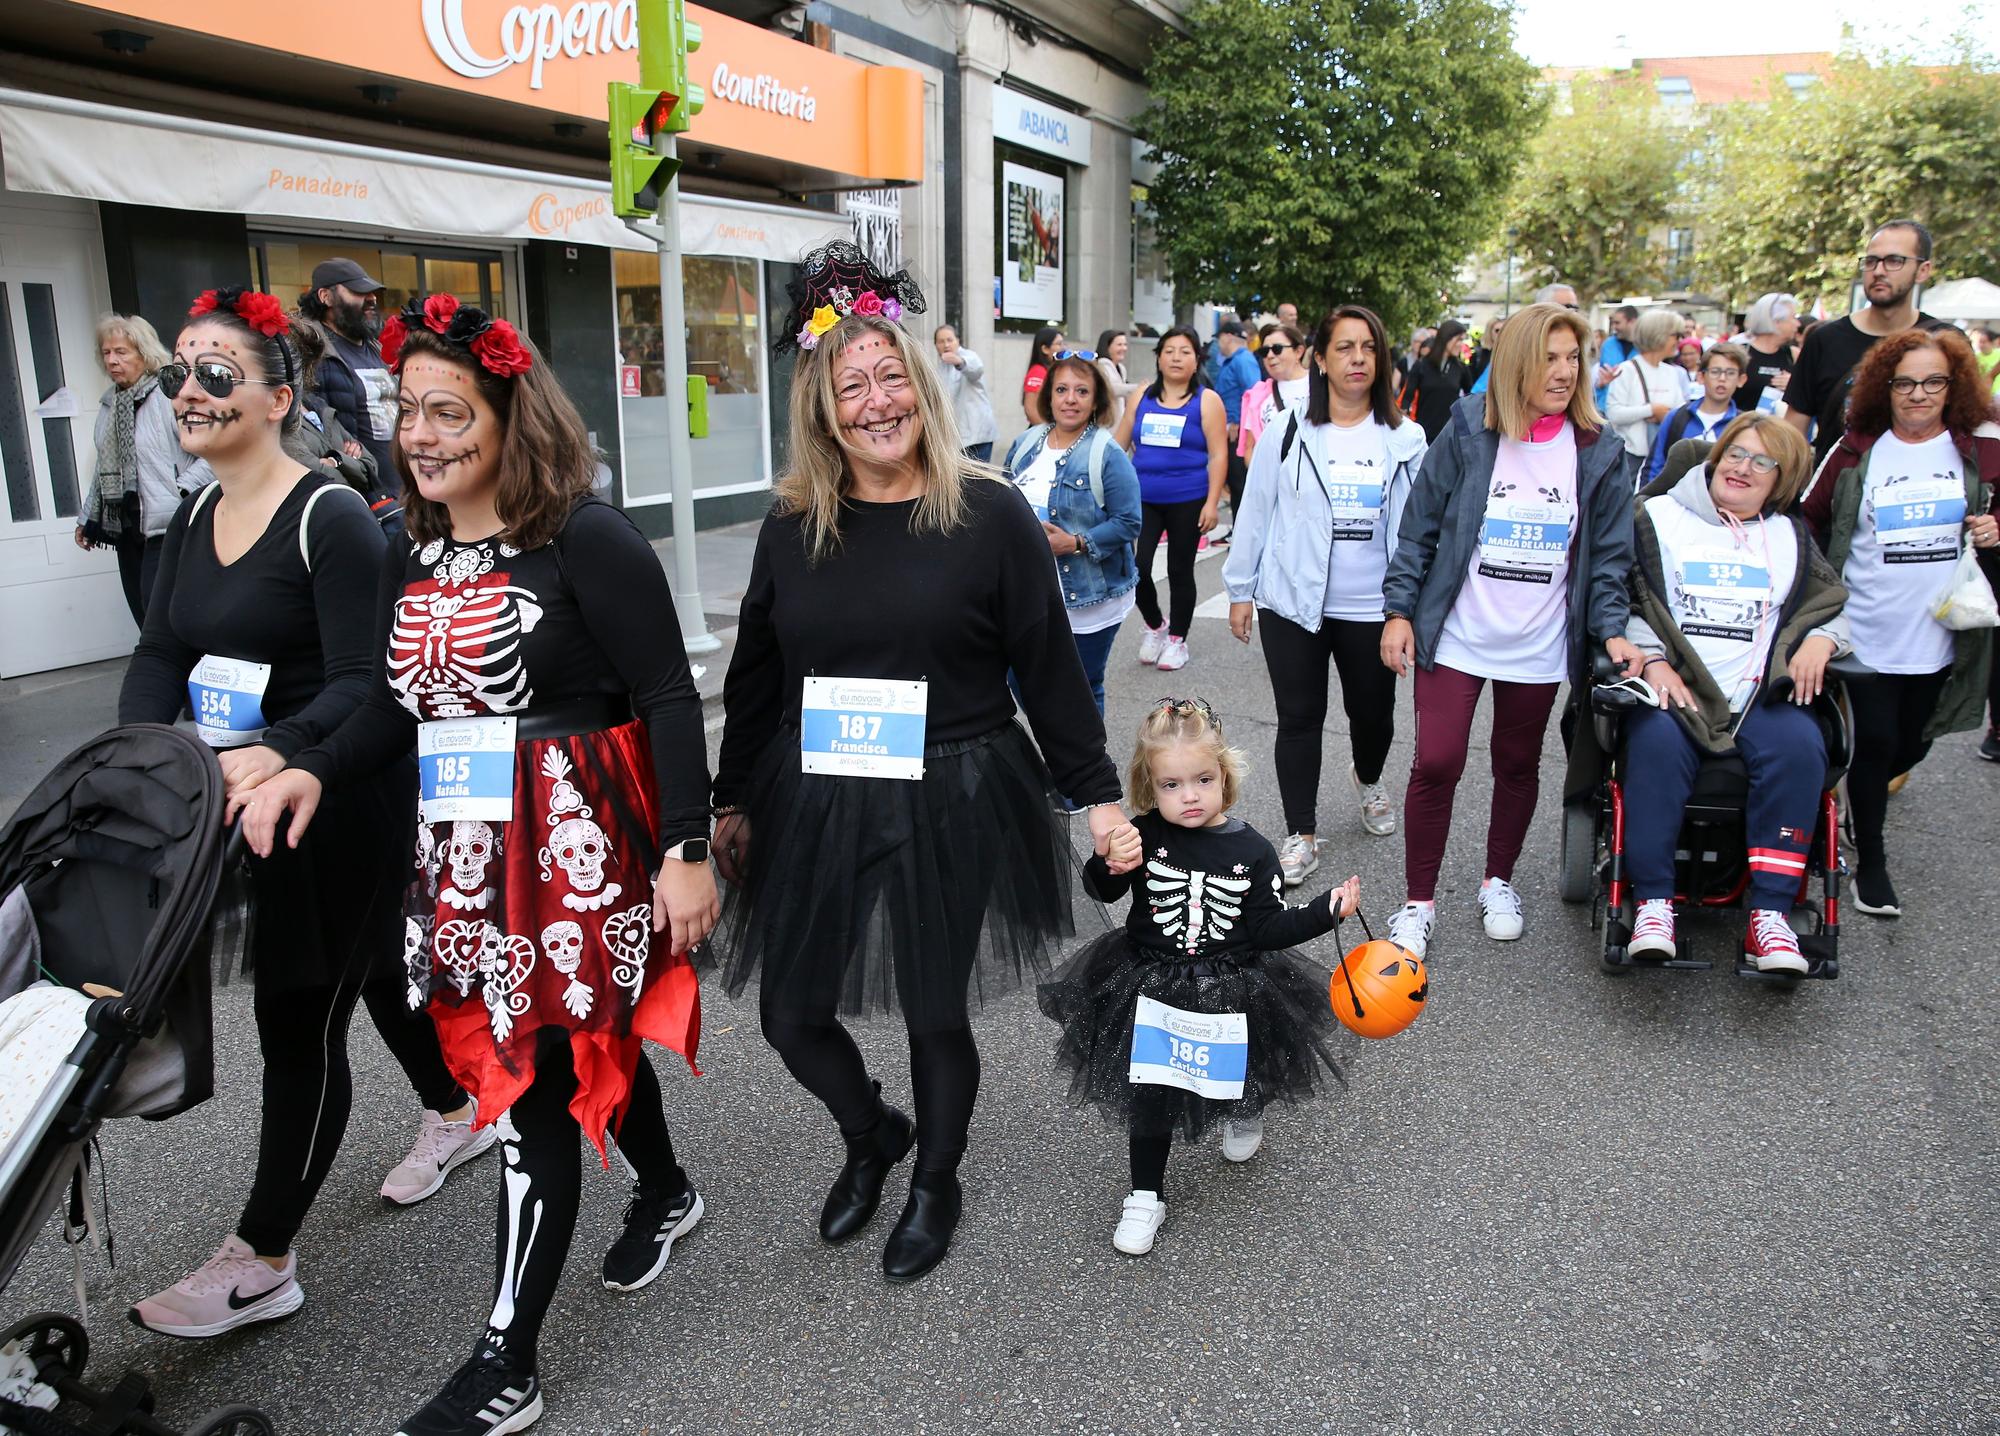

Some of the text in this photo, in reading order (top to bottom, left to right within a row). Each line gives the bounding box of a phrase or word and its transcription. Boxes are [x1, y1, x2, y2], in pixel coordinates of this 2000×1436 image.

[712, 63, 816, 122] Confitería
[1024, 110, 1069, 146] ABANCA
[268, 168, 368, 200] Panadería
[1153, 425, 1171, 434] 305
[1331, 485, 1358, 499] 335
[1903, 503, 1936, 521] 557
[1510, 523, 1543, 541] 333
[1488, 537, 1563, 550] MARIA DE LA PAZ
[1708, 564, 1743, 579] 334
[1682, 625, 1698, 633] pola
[1699, 627, 1728, 636] esclerose
[201, 689, 232, 716] 554
[202, 713, 230, 729] Melisa
[838, 714, 883, 740] 187
[831, 740, 889, 755] Francisca
[436, 756, 471, 782] 185
[435, 783, 470, 797] Natalia
[1169, 1036, 1210, 1066] 186
[1169, 1056, 1208, 1078] Carlota
